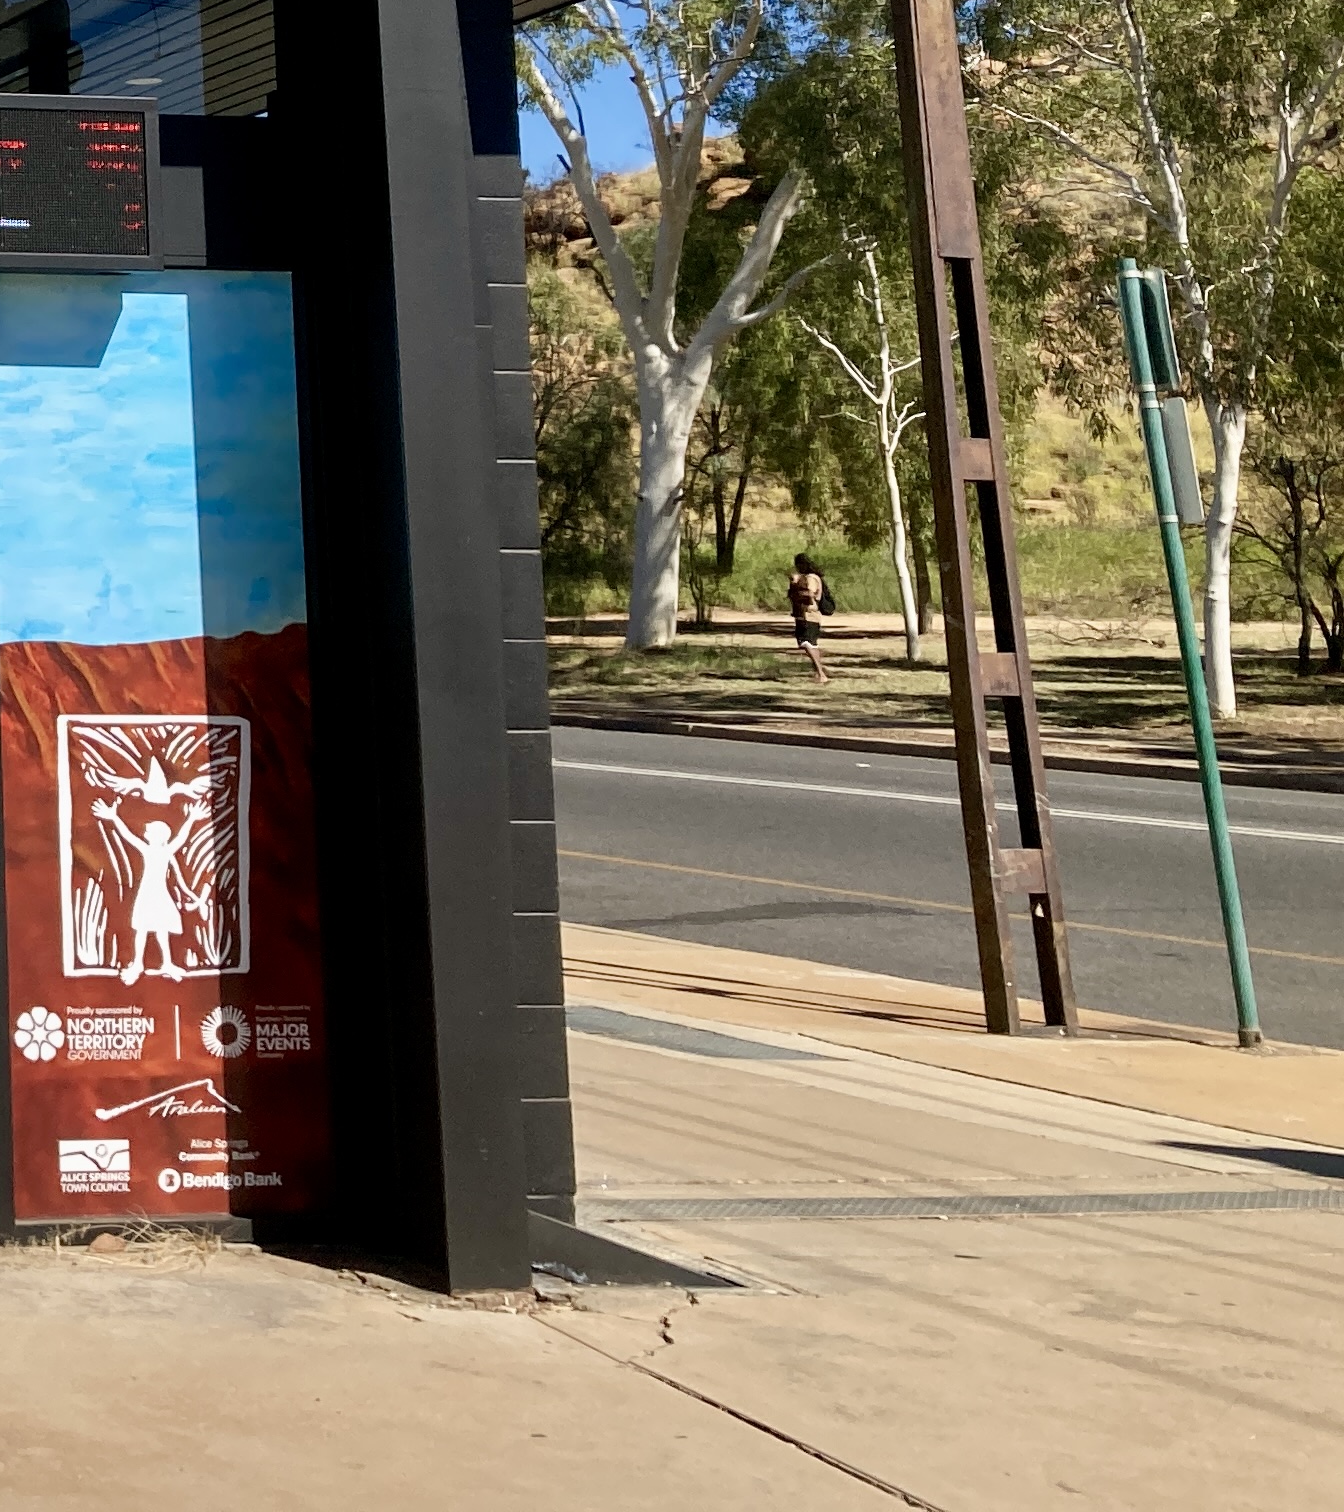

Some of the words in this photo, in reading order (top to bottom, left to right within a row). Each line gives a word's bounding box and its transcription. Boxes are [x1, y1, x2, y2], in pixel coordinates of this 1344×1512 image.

[66, 1017, 155, 1034] NORTHERN
[255, 1023, 310, 1037] MAJOR
[66, 1034, 146, 1050] TERRITORY
[256, 1037, 311, 1050] EVENTS
[67, 1049, 142, 1061] GOVERNMENT
[60, 1172, 89, 1182] ALICE
[88, 1172, 131, 1182] SPRINGS
[182, 1171, 242, 1190] Bendigo
[243, 1171, 283, 1187] Bank
[60, 1182, 90, 1193] TOWN
[90, 1182, 132, 1192] COUNCIL
